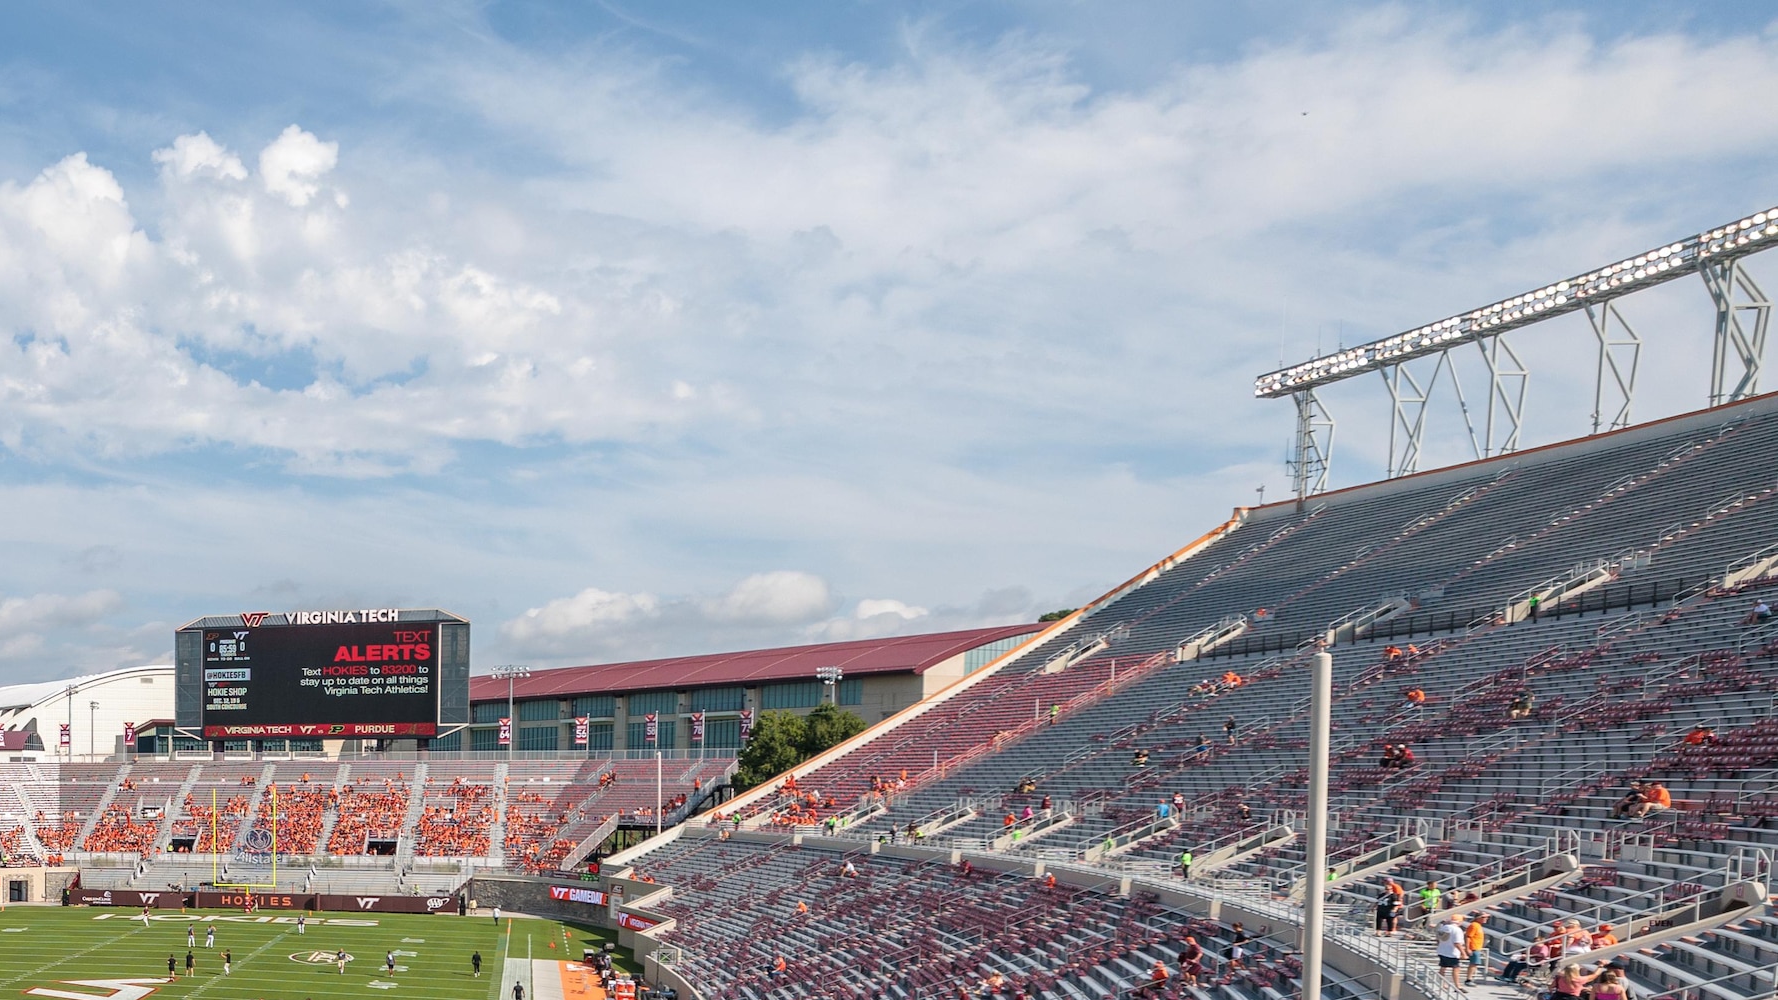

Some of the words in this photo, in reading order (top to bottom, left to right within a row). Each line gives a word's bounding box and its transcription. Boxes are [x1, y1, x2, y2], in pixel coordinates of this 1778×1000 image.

[241, 612, 270, 627] VT
[284, 610, 357, 625] VIRGINIA
[360, 609, 400, 623] TECH
[393, 631, 432, 643] TEXT
[334, 644, 431, 662] ALERTS
[207, 671, 246, 679] @HOKIESFB
[302, 668, 322, 676] Text
[323, 666, 368, 675] HOKIES
[370, 667, 380, 675] to
[381, 665, 416, 674] 83200
[418, 665, 429, 673] to
[300, 678, 320, 687] stay
[321, 678, 335, 686] up
[337, 677, 346, 685] to
[348, 676, 370, 685] date
[386, 676, 397, 684] all
[399, 675, 429, 685] things
[208, 688, 228, 696] HOKIE
[229, 687, 247, 696] SHOP
[324, 686, 359, 697] Virginia
[360, 685, 383, 694] Tech
[384, 685, 429, 693] Athletics!
[224, 726, 265, 734] VIRGINIA
[266, 725, 292, 733] TECH
[299, 725, 316, 734] VT
[355, 725, 395, 733] PURDUE
[499, 730, 510, 739] 64
[576, 729, 587, 738] 56
[139, 893, 160, 904] VT
[552, 887, 568, 899] VT
[569, 889, 603, 905] GAMEDAY
[356, 897, 380, 909] VT
[92, 913, 380, 927] HOKIES
[1649, 919, 1673, 927] EVEN
